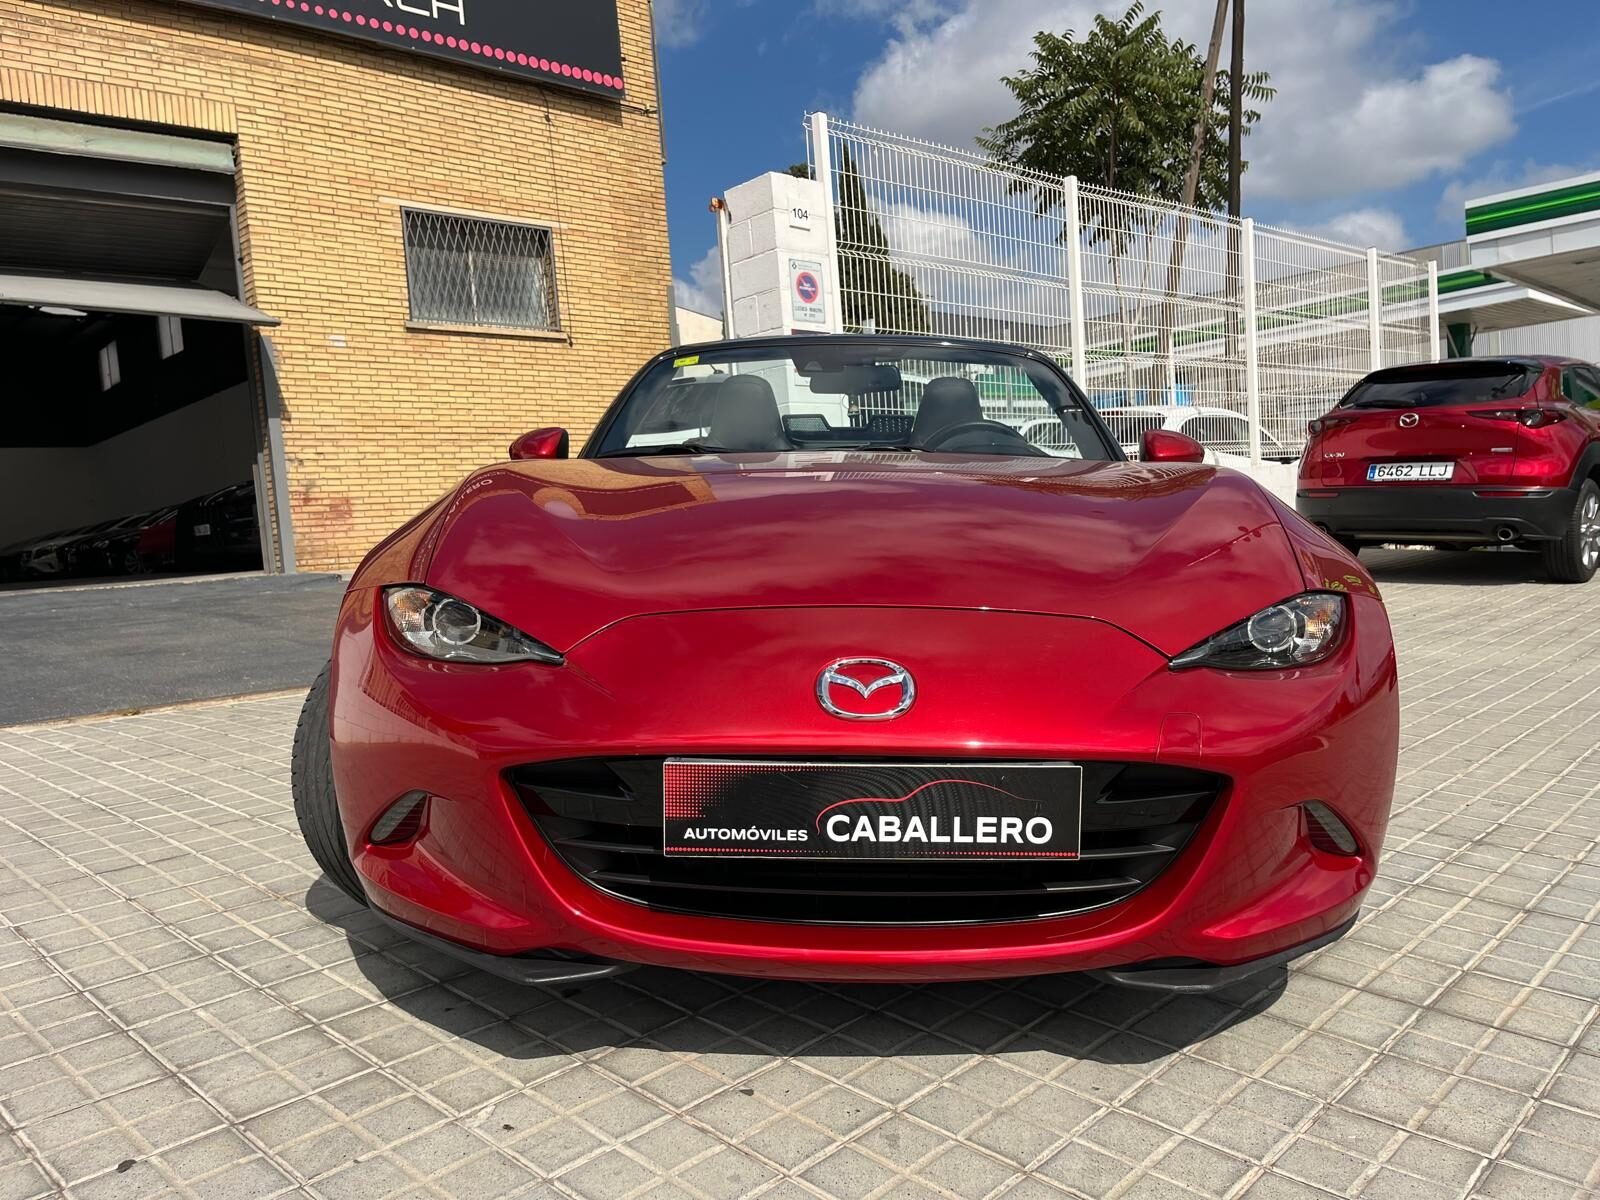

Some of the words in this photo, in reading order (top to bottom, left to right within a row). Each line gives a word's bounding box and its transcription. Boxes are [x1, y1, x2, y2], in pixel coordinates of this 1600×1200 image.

[792, 207, 809, 220] 104
[1377, 464, 1414, 477] 6462
[1418, 464, 1448, 477] LLJ
[683, 825, 809, 841] AUTOMÓVILES
[826, 814, 1053, 844] CABALLERO
